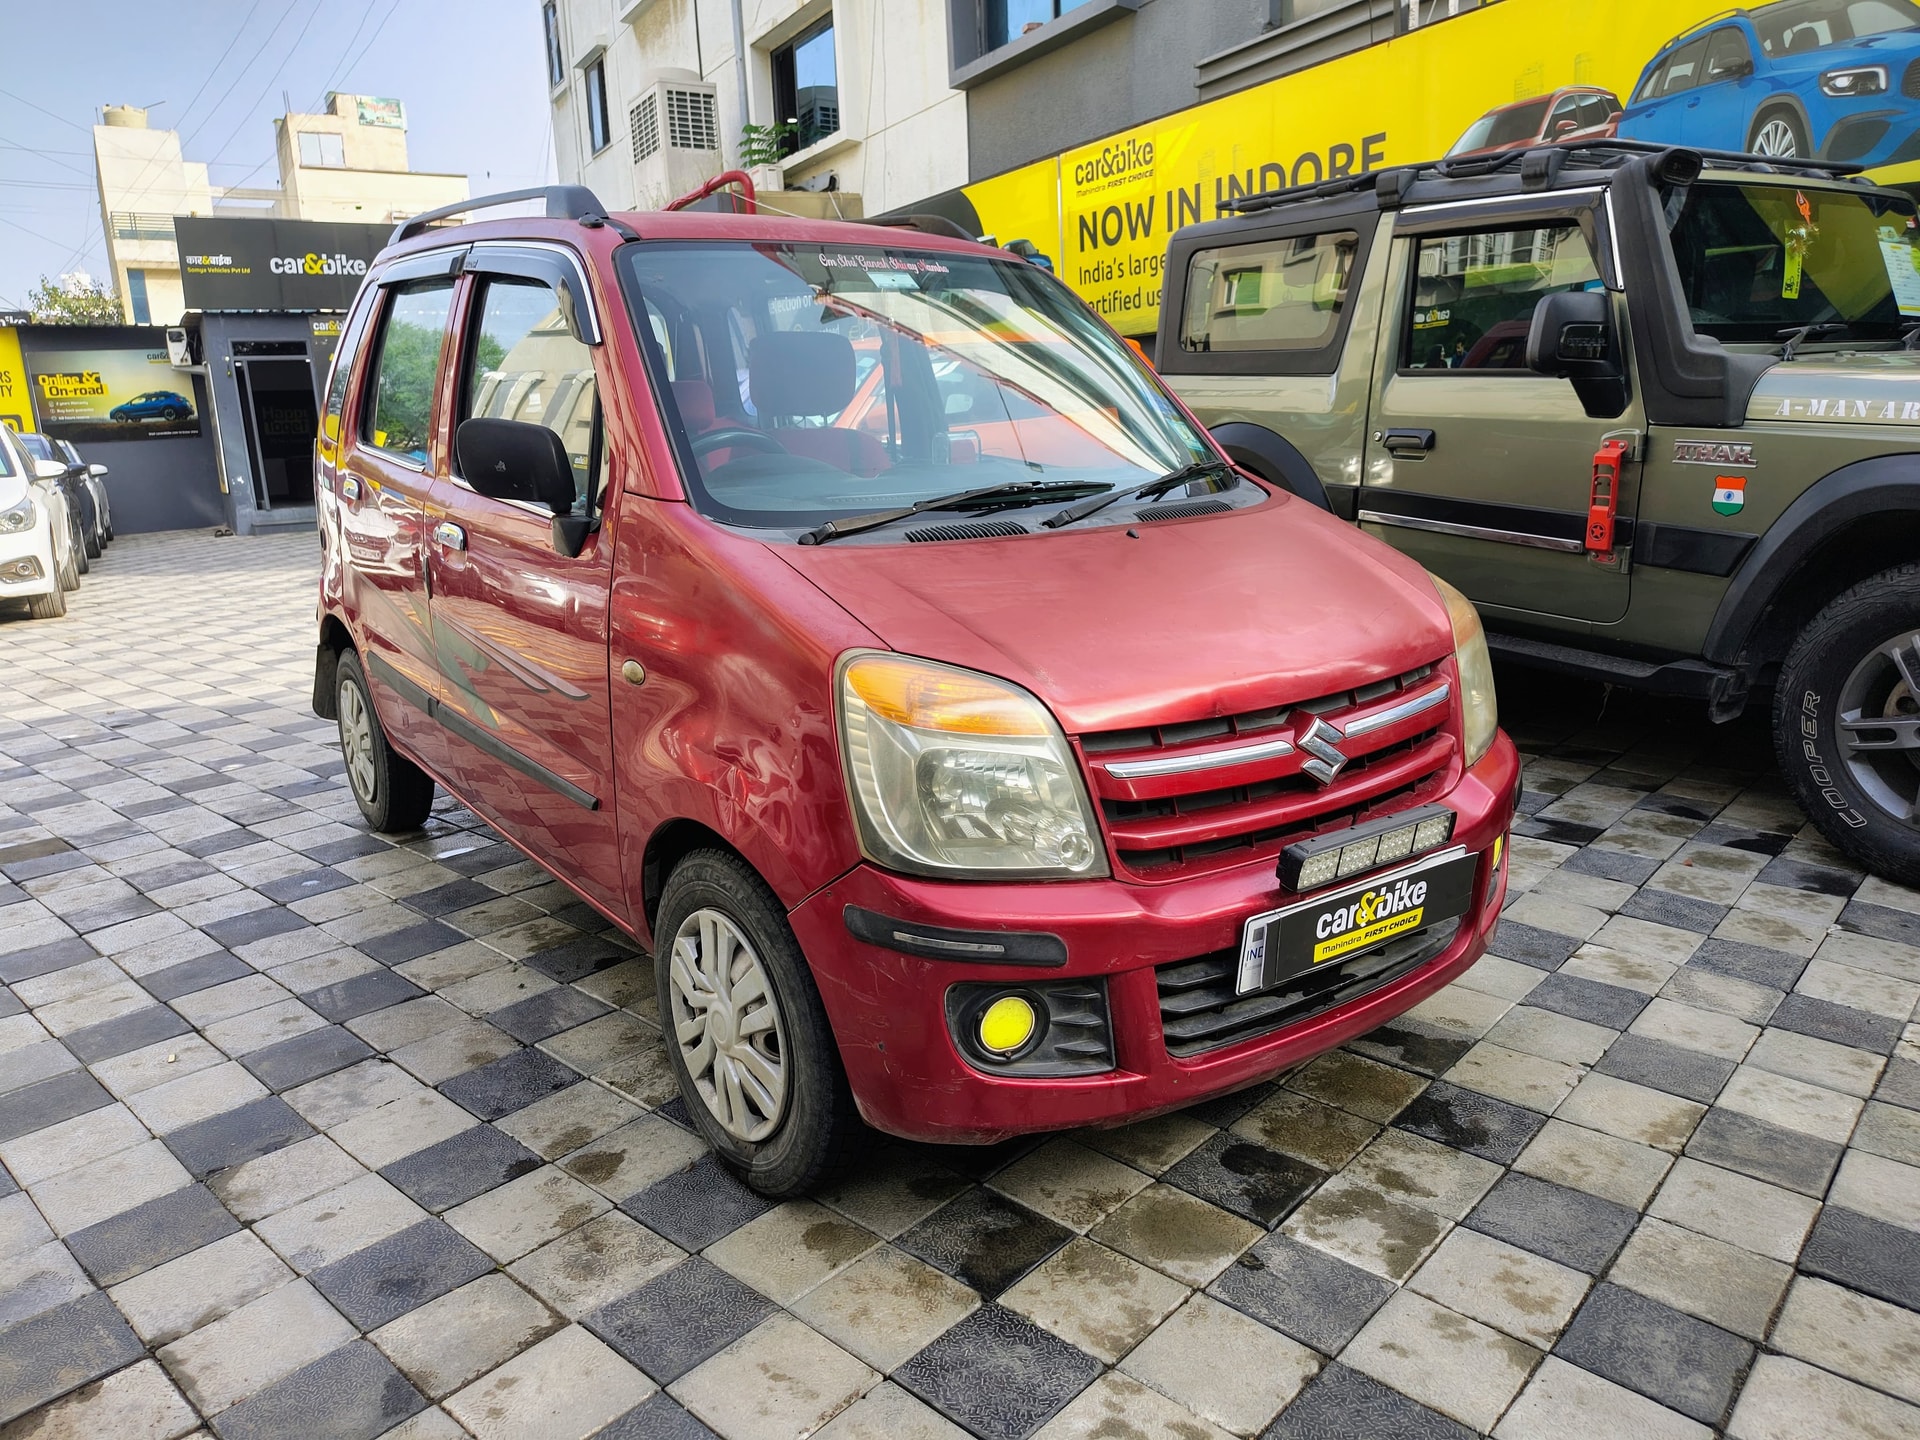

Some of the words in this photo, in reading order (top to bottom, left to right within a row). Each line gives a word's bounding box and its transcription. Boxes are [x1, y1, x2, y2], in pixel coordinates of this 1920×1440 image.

[1075, 138, 1154, 186] car&bike
[1076, 184, 1106, 198] Mahindra
[1107, 177, 1127, 189] FIRST
[1128, 169, 1154, 183] CHOICE
[1079, 196, 1155, 252] NOW
[1167, 183, 1200, 232] IN
[270, 253, 367, 276] car&bike
[38, 374, 79, 387] Online
[49, 384, 104, 396] On-road
[1774, 399, 1872, 418] A-MAN
[1674, 442, 1757, 465] THAR
[1801, 690, 1867, 828] COOPER
[1316, 879, 1428, 939] car&bike
[1322, 936, 1362, 954] Mahindra
[1364, 925, 1389, 940] FIRST
[1389, 914, 1418, 930] CHOICE
